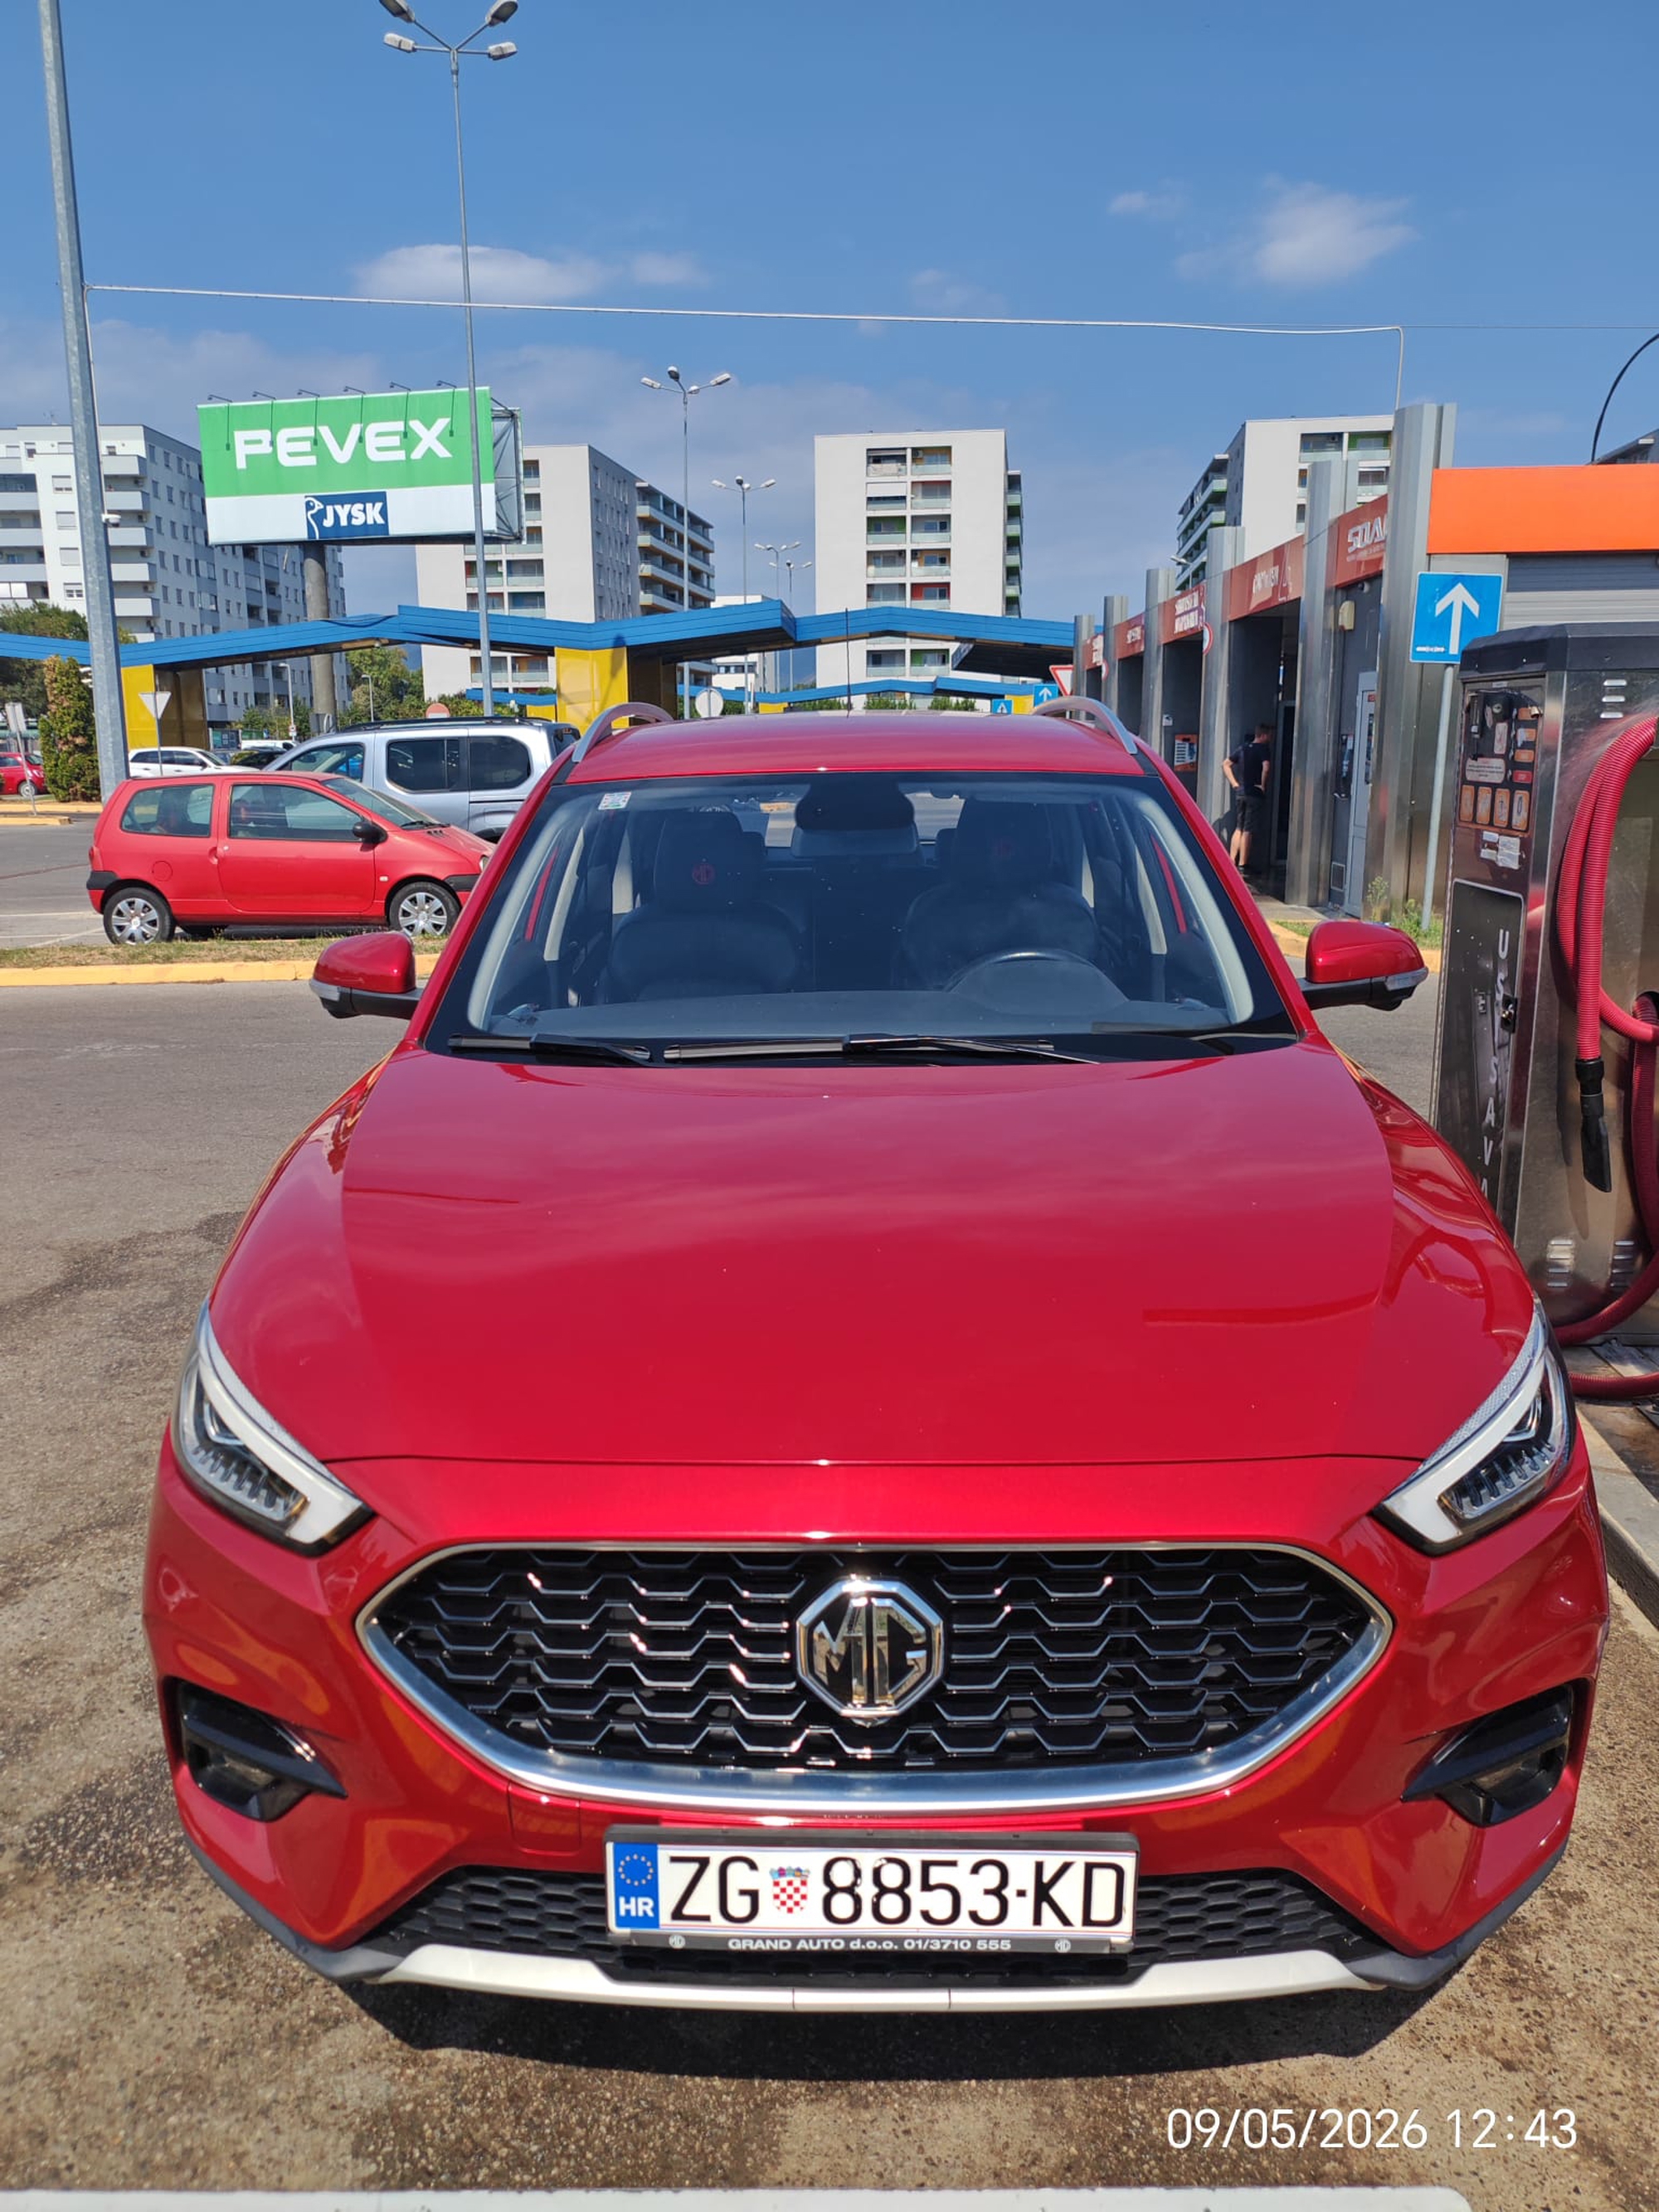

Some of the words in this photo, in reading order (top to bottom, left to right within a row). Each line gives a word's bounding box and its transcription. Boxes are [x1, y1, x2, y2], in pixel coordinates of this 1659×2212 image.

[233, 417, 453, 469] PEVEX
[323, 502, 386, 527] JYSK
[813, 1597, 927, 1705] MG
[619, 1896, 654, 1918] HR
[669, 1855, 760, 1924] ZG
[728, 1937, 792, 1950] GRAND
[795, 1937, 844, 1951] AUTO
[849, 1937, 898, 1951] d.o.o.
[903, 1938, 971, 1951] 01/3710
[975, 1938, 1012, 1951] 555
